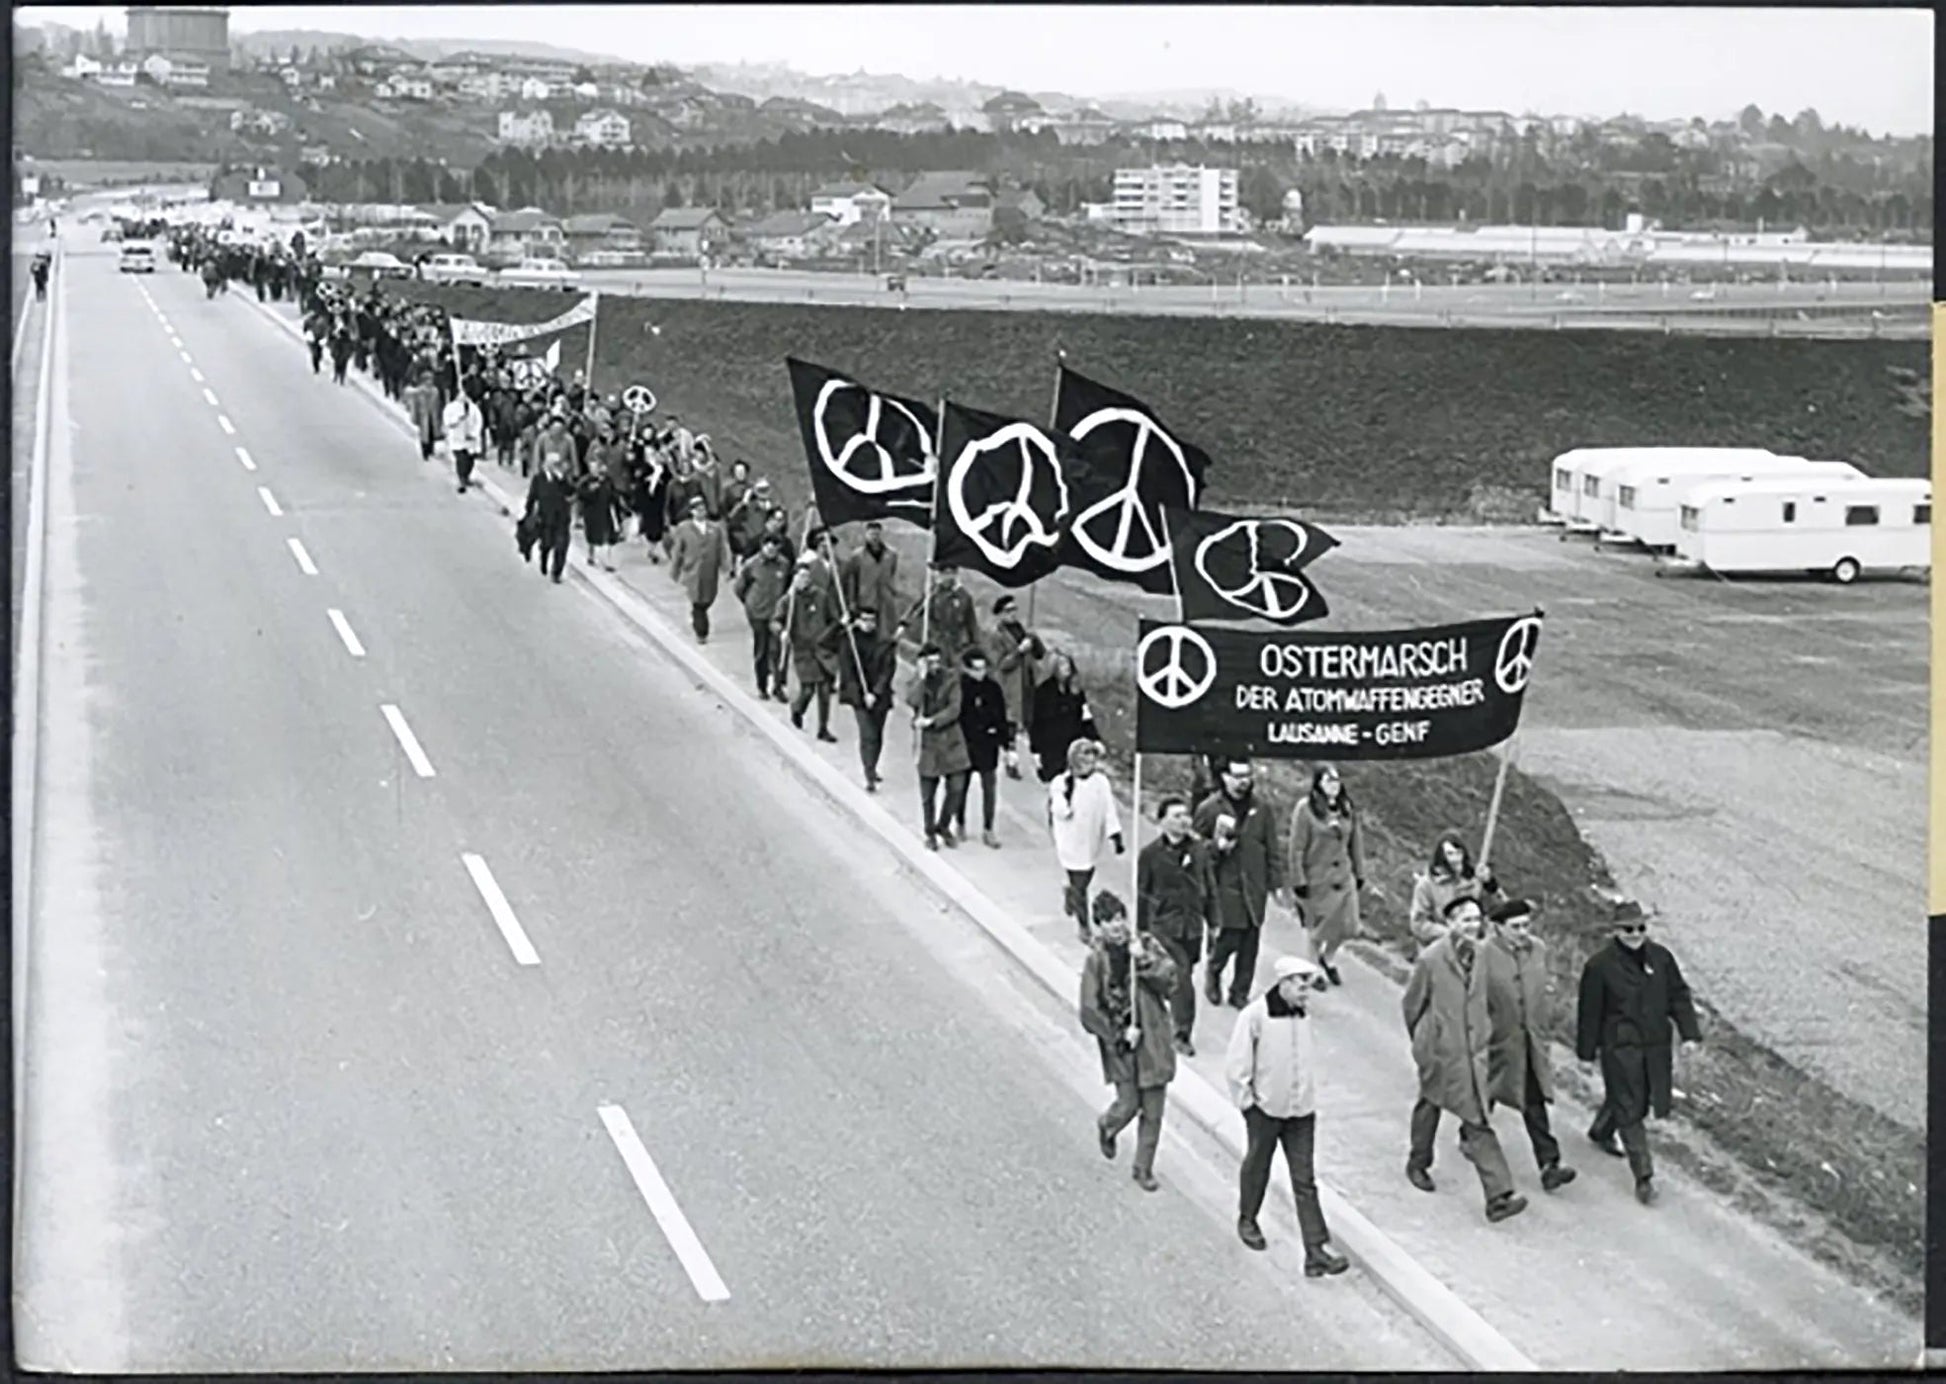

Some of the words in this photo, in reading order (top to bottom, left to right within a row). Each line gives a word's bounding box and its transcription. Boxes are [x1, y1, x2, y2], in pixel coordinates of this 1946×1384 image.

[1260, 637, 1467, 678] OSTERMARSCH
[1236, 685, 1279, 711] DER
[1285, 678, 1485, 713] ATOMWAFFENGEGNER
[1268, 722, 1358, 745] LAUSANNE
[1376, 720, 1431, 745] GENF
